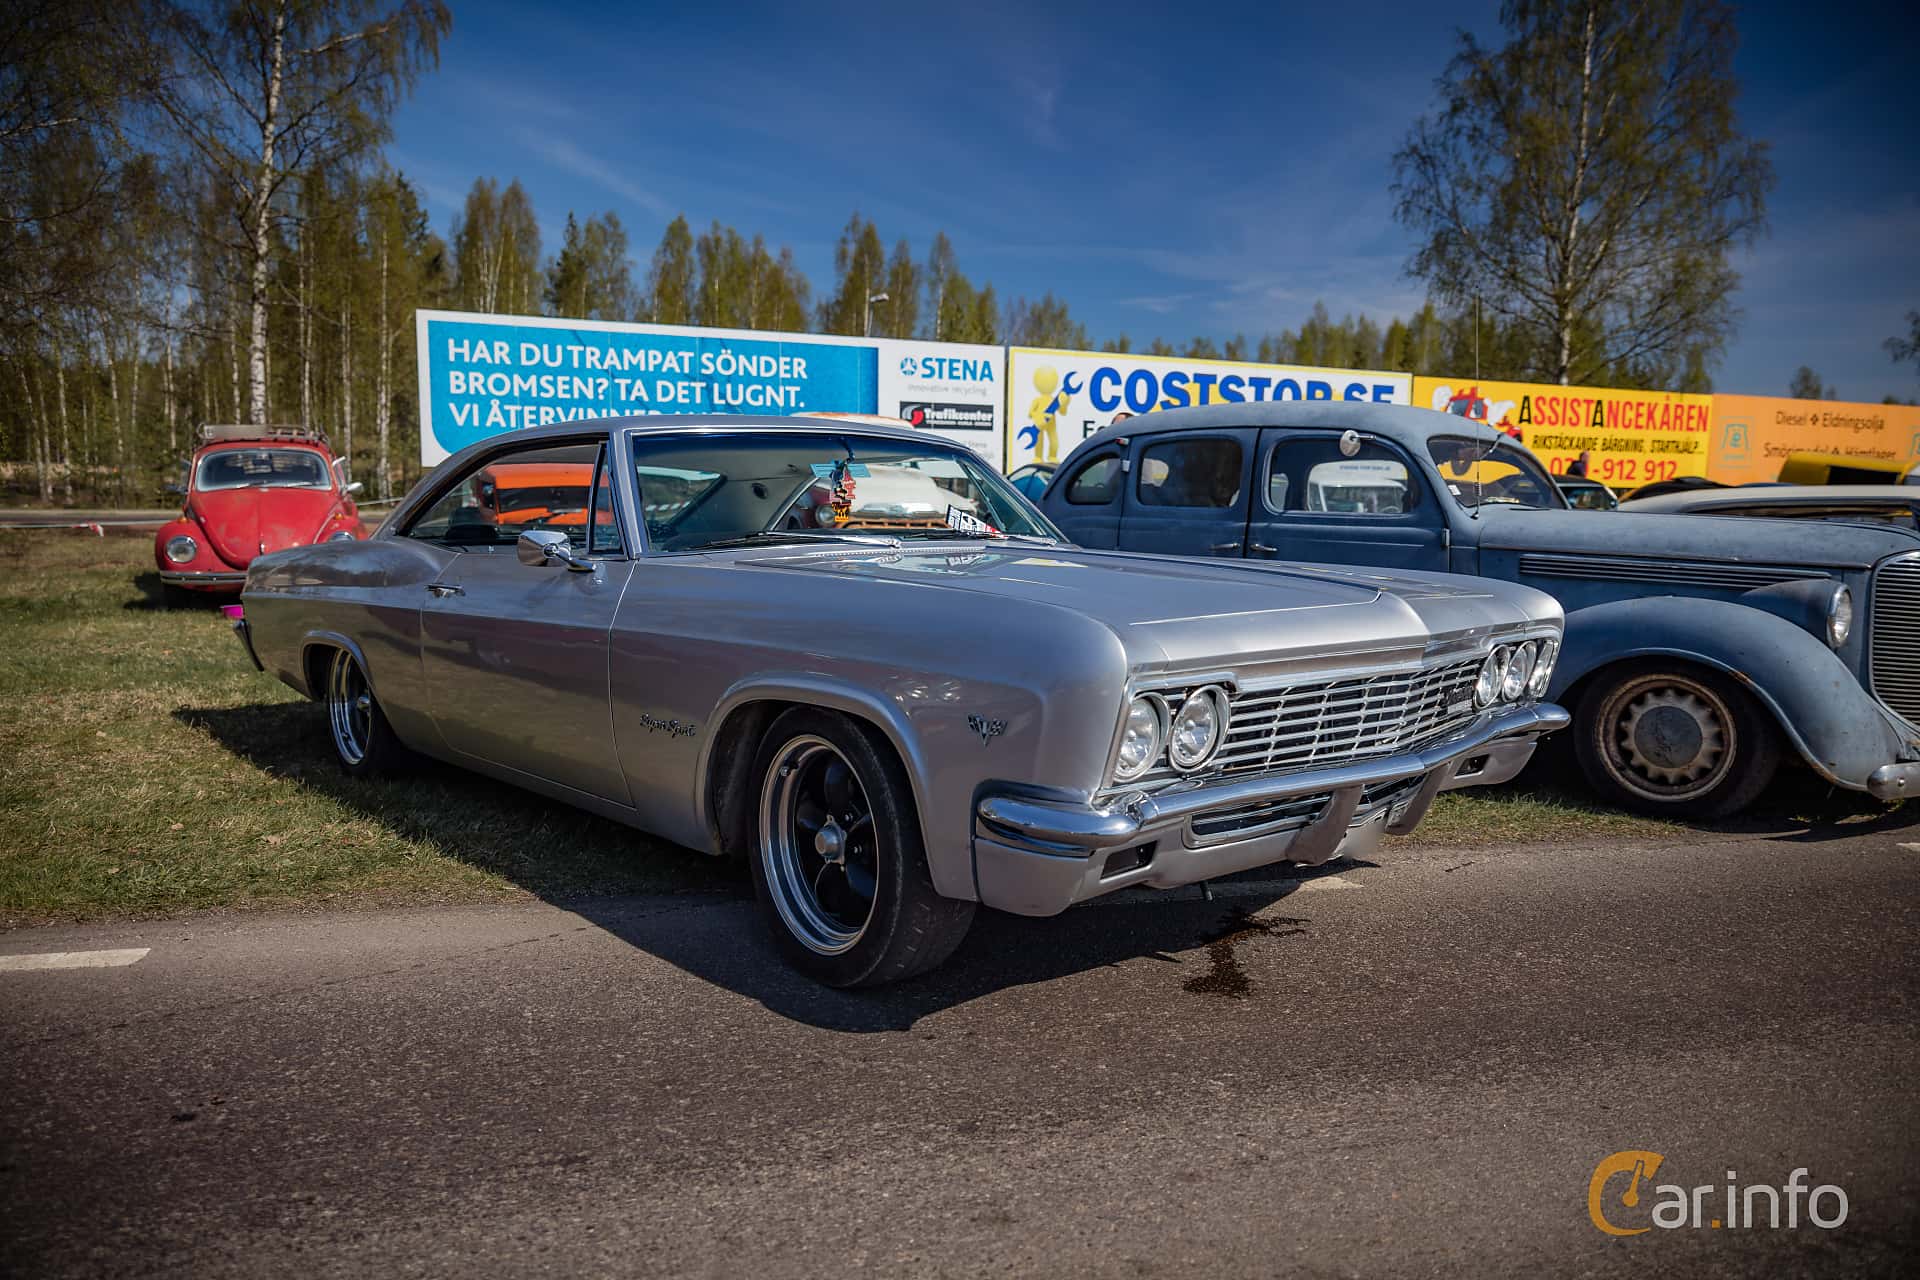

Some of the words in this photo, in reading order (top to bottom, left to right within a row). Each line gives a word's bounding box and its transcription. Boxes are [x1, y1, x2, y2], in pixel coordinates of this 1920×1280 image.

[447, 338, 510, 365] HAR
[520, 343, 562, 368] DU
[567, 345, 694, 375] TRAMPAT
[700, 348, 808, 380] SÖNDER
[920, 356, 994, 382] STENA
[449, 371, 609, 401] BROMSEN?
[614, 378, 651, 402] TA
[656, 380, 706, 405] DET
[712, 383, 805, 408] LUGNT.
[449, 402, 479, 427] VI
[923, 407, 993, 422] Trafikcenter
[1518, 393, 1710, 433] ASSISTANCEKÅREN
[1776, 411, 1806, 426] Diesel
[1644, 459, 1678, 481] 912
